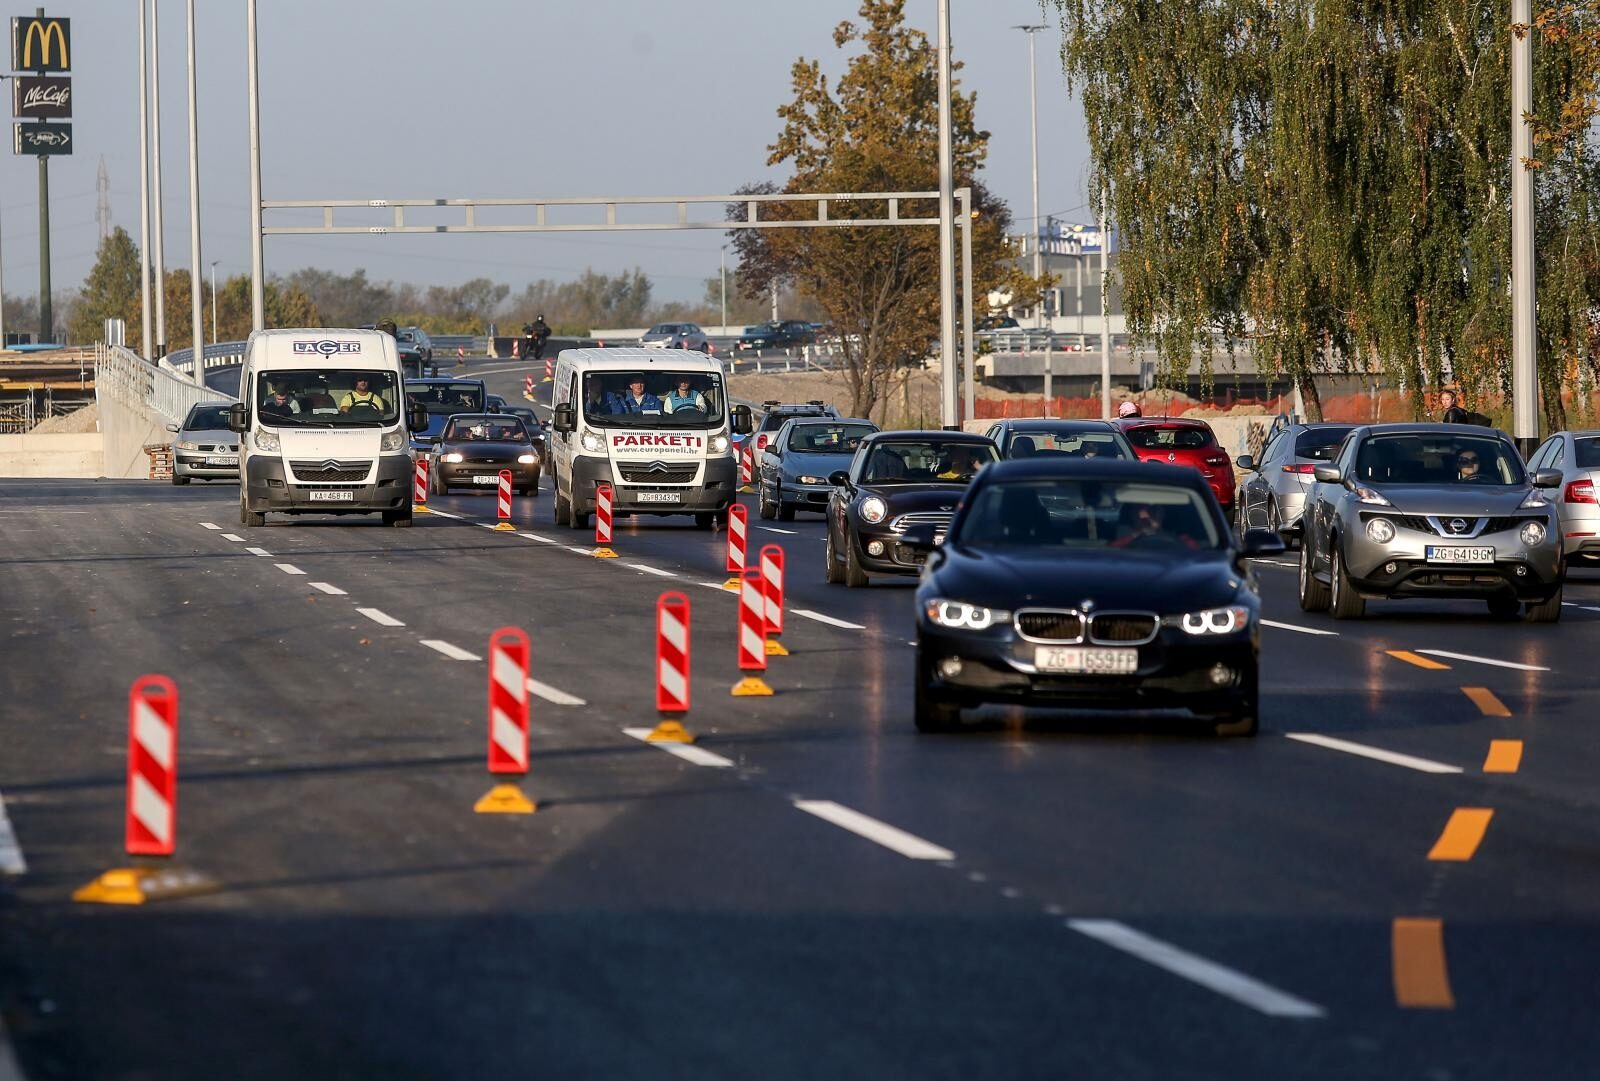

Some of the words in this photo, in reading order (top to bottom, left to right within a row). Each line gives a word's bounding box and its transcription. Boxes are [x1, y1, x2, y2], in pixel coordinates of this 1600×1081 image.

[294, 340, 360, 355] LAGER
[613, 435, 702, 447] PARKETI
[616, 447, 698, 455] www.europaneli.hr
